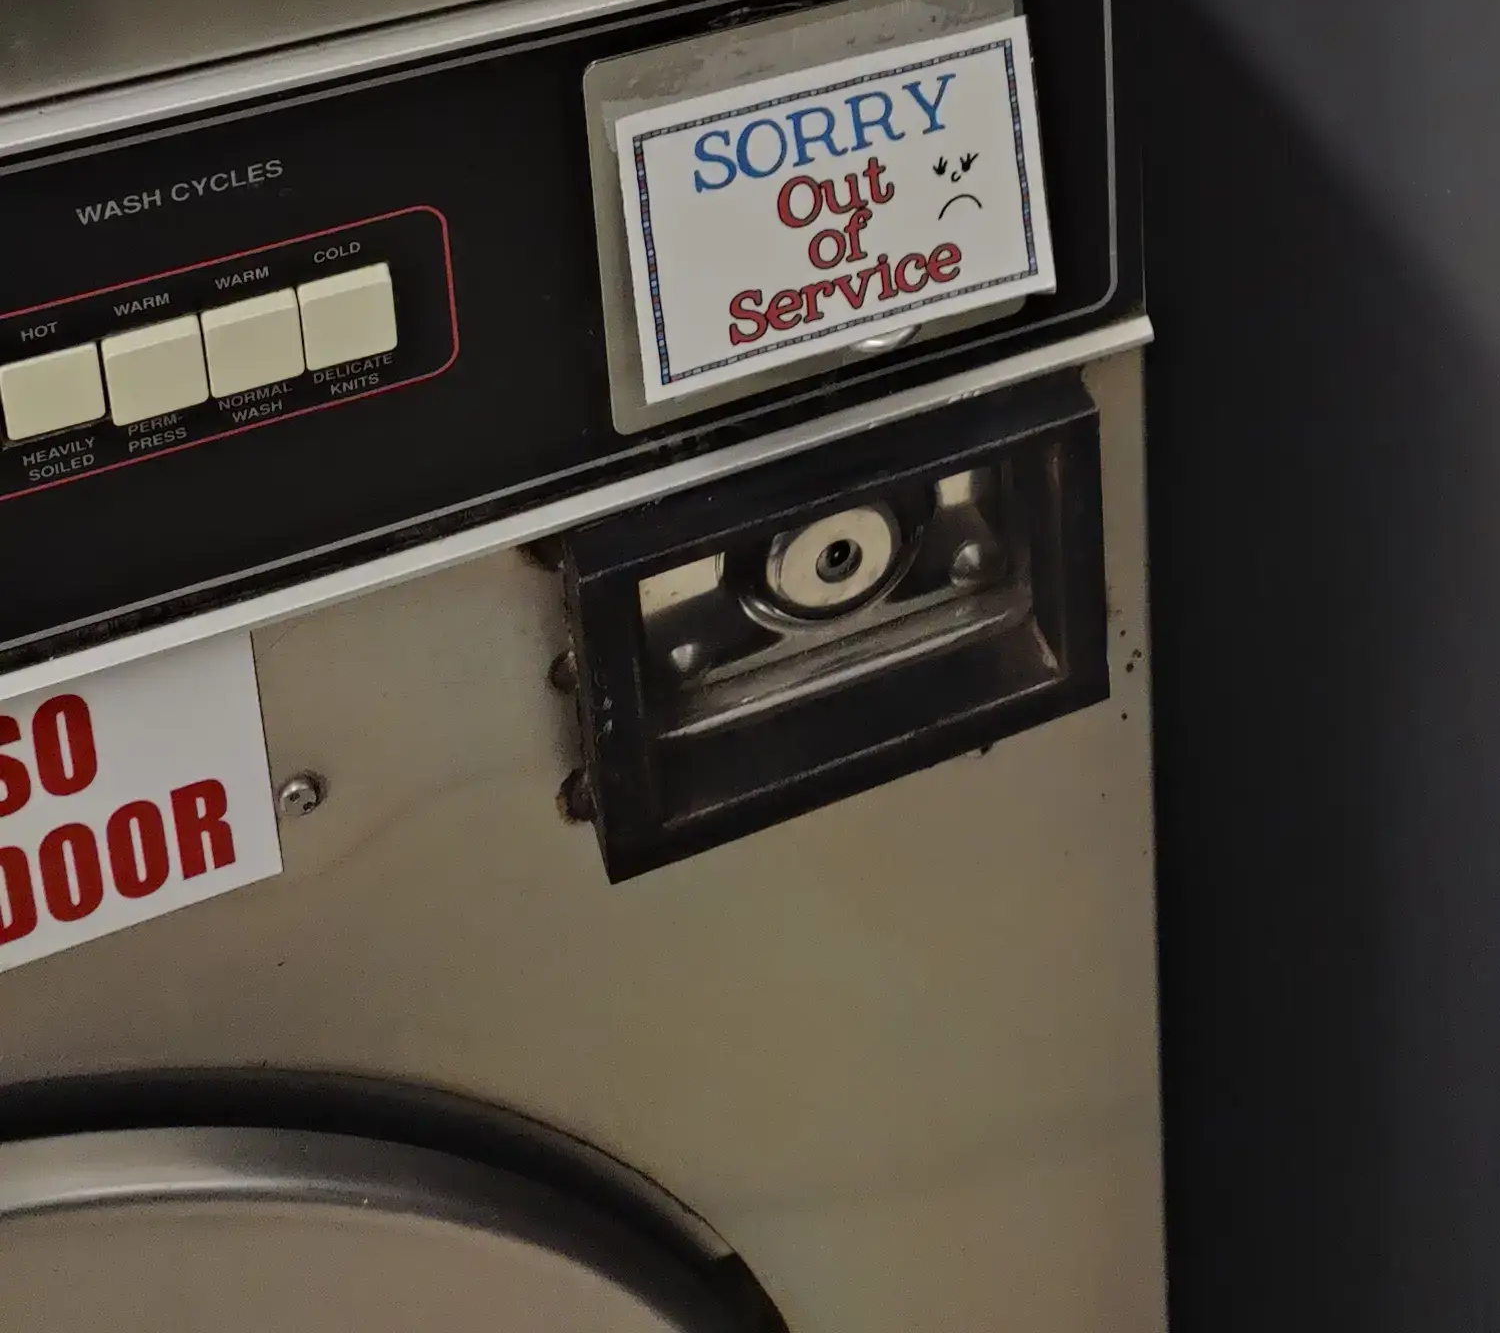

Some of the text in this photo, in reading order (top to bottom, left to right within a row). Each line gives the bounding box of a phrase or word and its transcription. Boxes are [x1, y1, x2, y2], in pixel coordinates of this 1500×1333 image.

[693, 73, 956, 193] SORRY
[75, 159, 284, 226] WASH CYCLES
[776, 156, 895, 228] Out
[313, 241, 361, 264] COLD
[807, 207, 873, 270] of
[214, 266, 270, 291] WARM
[113, 292, 171, 318] WARM
[728, 242, 963, 346] Service
[20, 321, 59, 343] HOT
[313, 352, 394, 385] DELICATE
[330, 371, 381, 396] KNITS
[218, 382, 293, 412] NORMAL
[231, 400, 284, 424] WASH
[22, 436, 96, 467] HEAVILY
[128, 426, 188, 453] PRESS
[29, 453, 96, 482] SOILED
[0, 778, 236, 946] DOOR
